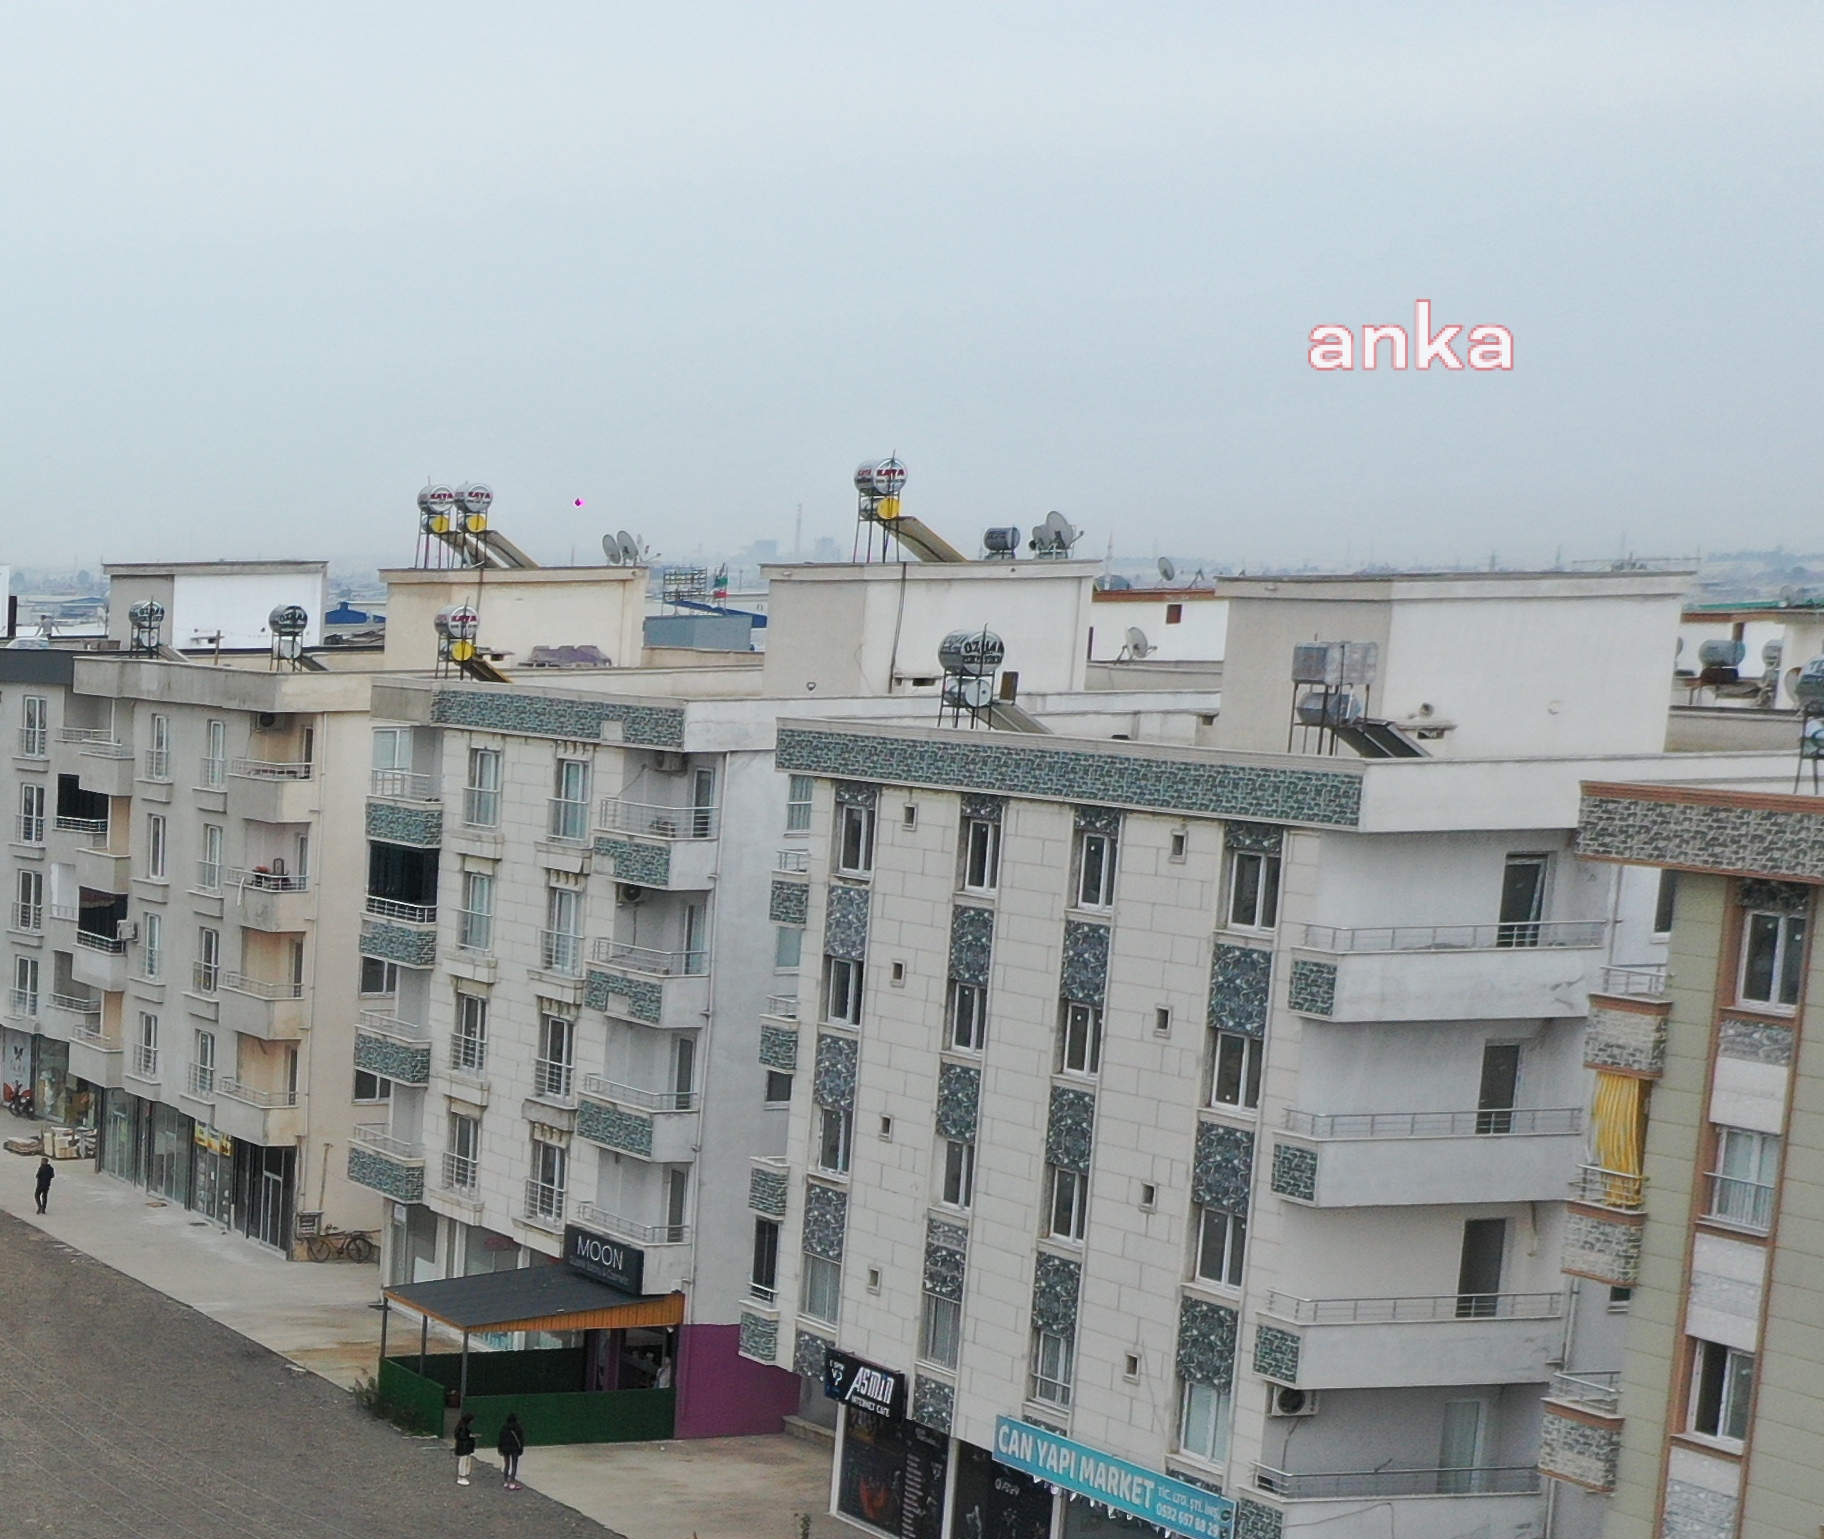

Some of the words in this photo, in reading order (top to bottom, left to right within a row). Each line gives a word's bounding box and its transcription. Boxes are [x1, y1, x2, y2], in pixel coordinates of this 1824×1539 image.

[577, 1235, 624, 1270] MOON
[998, 1424, 1034, 1464] CAN
[1036, 1438, 1077, 1480] YAPI
[1078, 1456, 1155, 1510] MARKET
